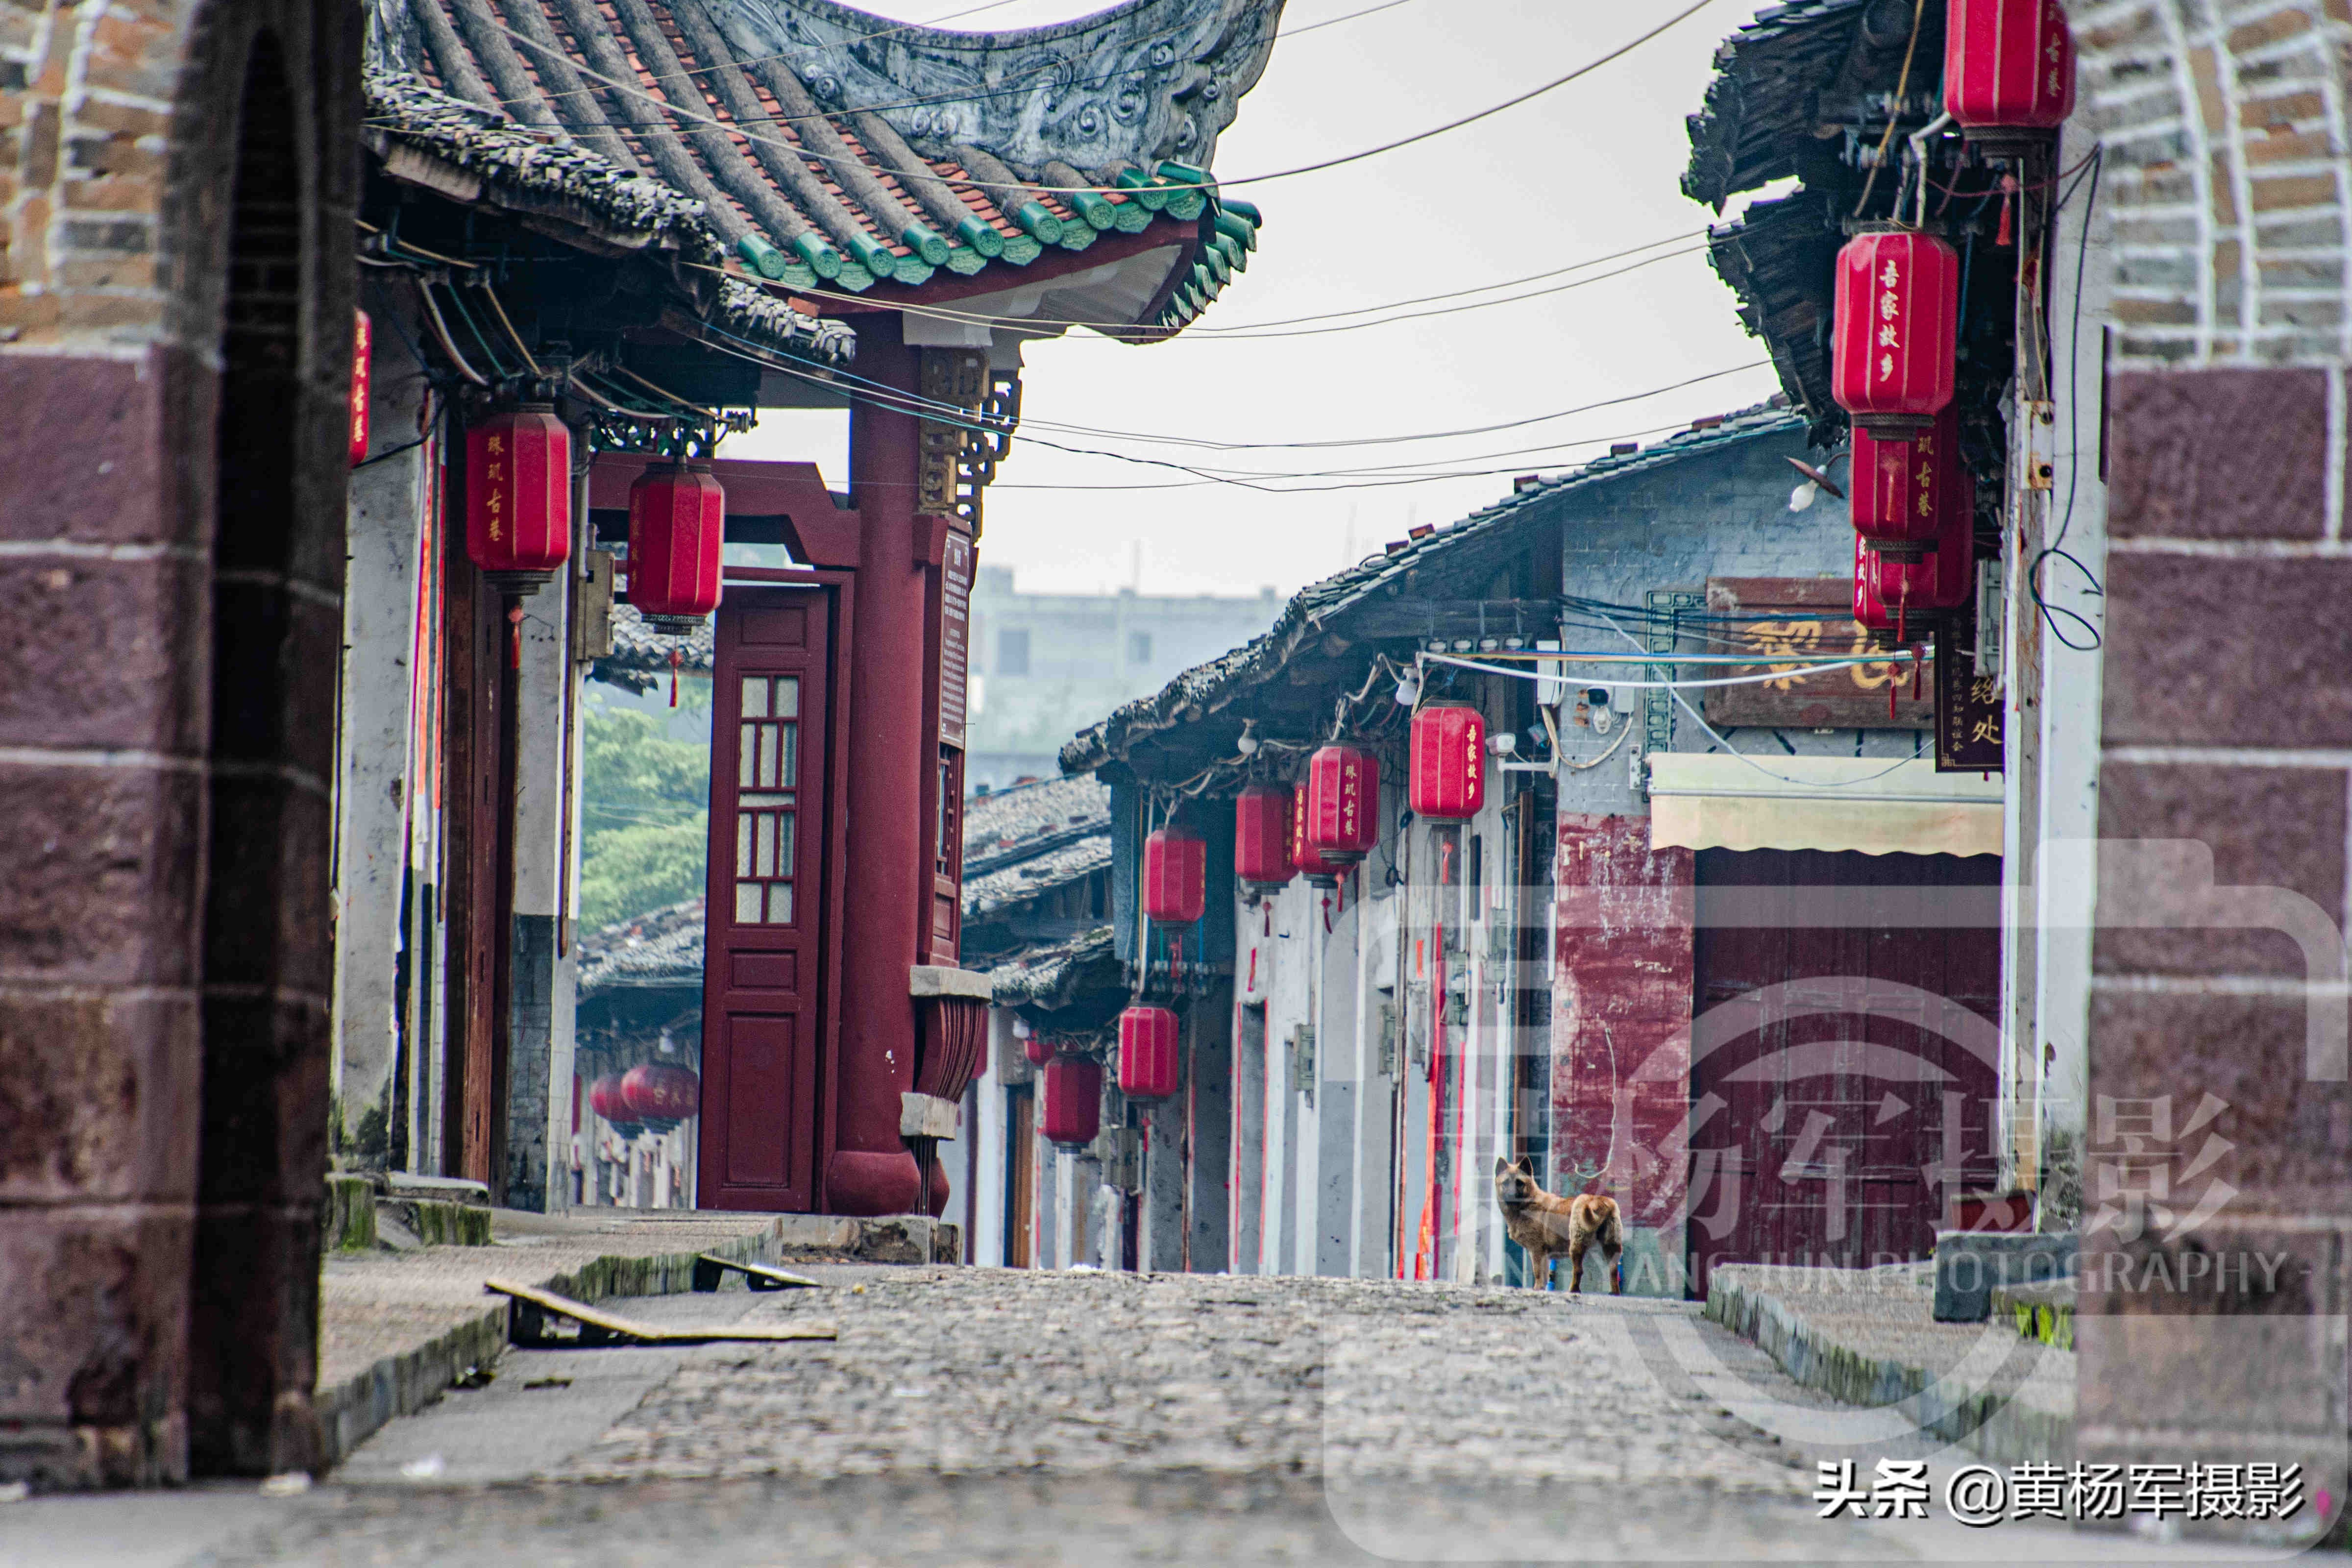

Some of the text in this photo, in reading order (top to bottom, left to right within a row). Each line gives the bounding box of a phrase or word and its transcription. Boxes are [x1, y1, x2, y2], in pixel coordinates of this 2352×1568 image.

[1879, 259, 1900, 382] 吾家故乡
[487, 435, 505, 541] 珠玑古巷
[1915, 435, 1935, 517] 玑古巷
[1343, 763, 1357, 835] 珠玑古巷
[1467, 724, 1477, 800] 吾家故乡
